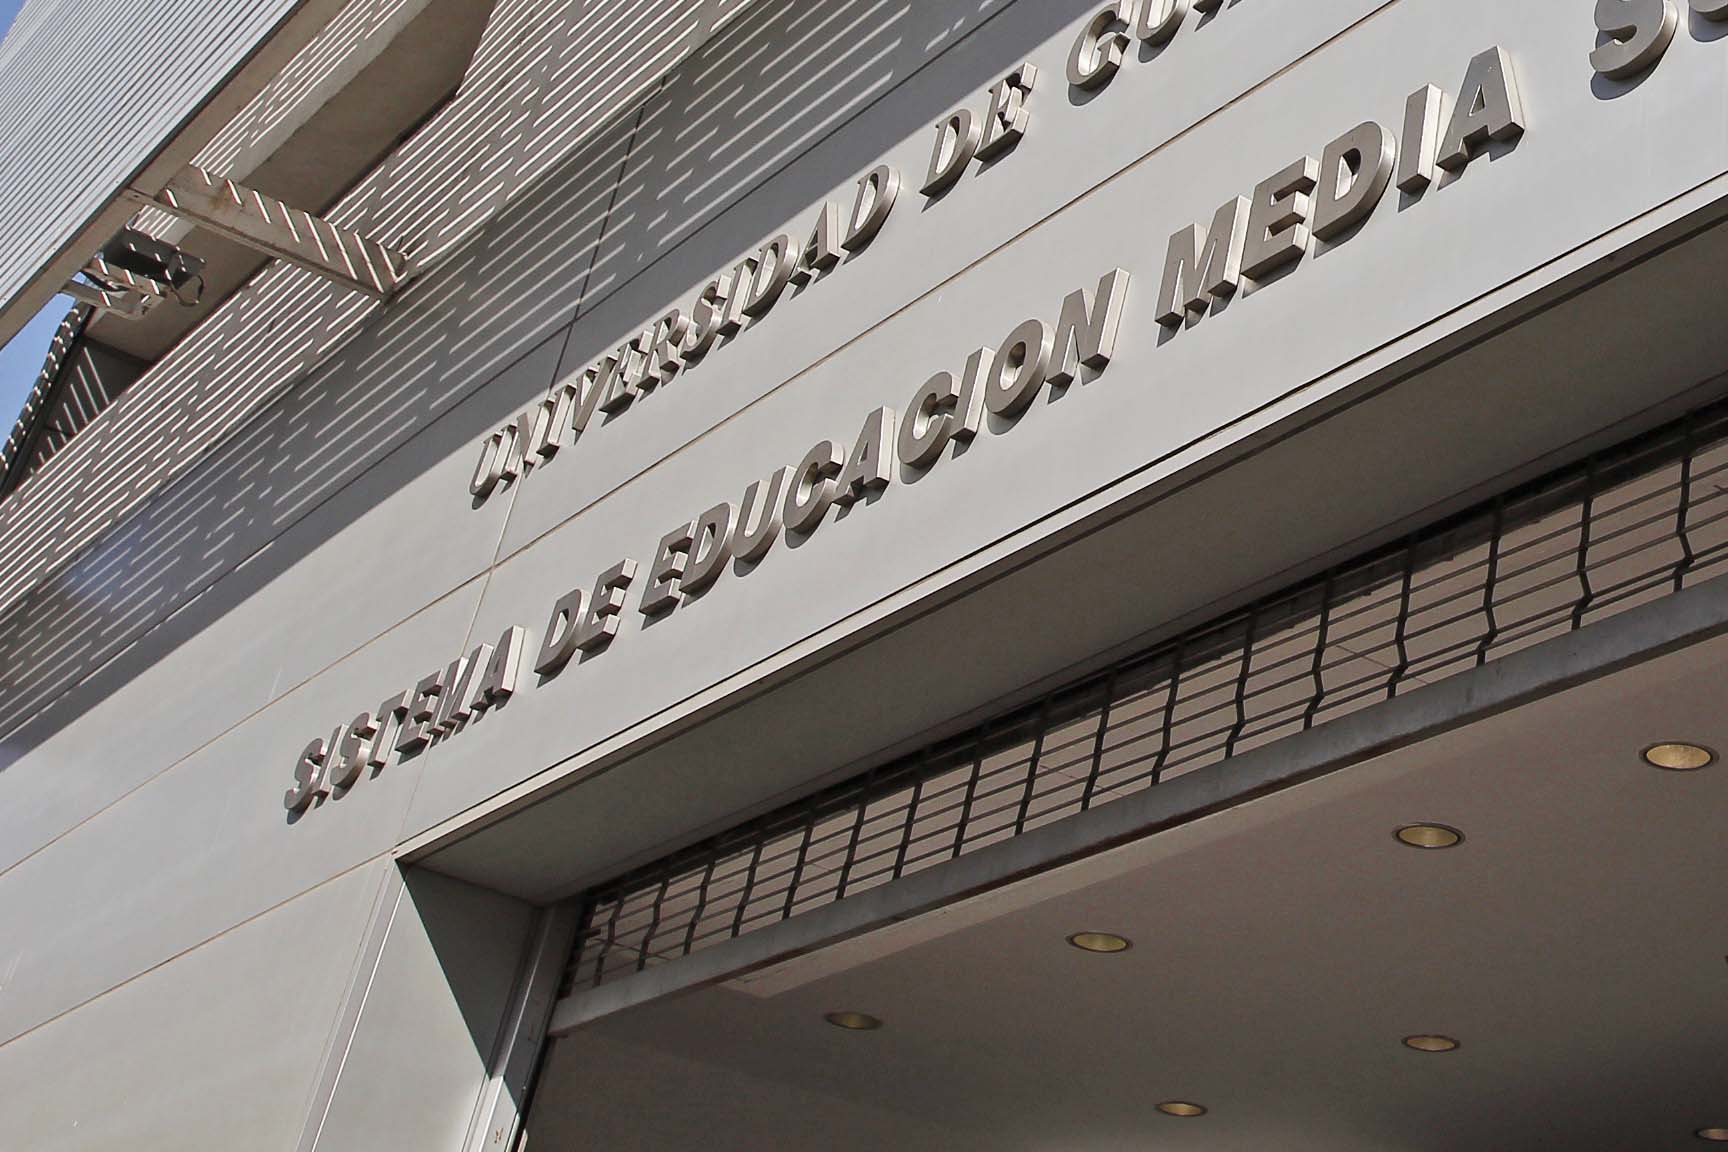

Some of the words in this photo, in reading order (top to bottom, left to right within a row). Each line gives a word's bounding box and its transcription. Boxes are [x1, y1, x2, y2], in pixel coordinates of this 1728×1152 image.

[284, 625, 530, 813] SISTEMA
[534, 557, 637, 676] DE
[639, 268, 1130, 616] EDUCACION
[1155, 45, 1525, 328] MEDIA
[469, 164, 901, 497] UNIVERSIDAD
[920, 62, 1037, 198] DE
